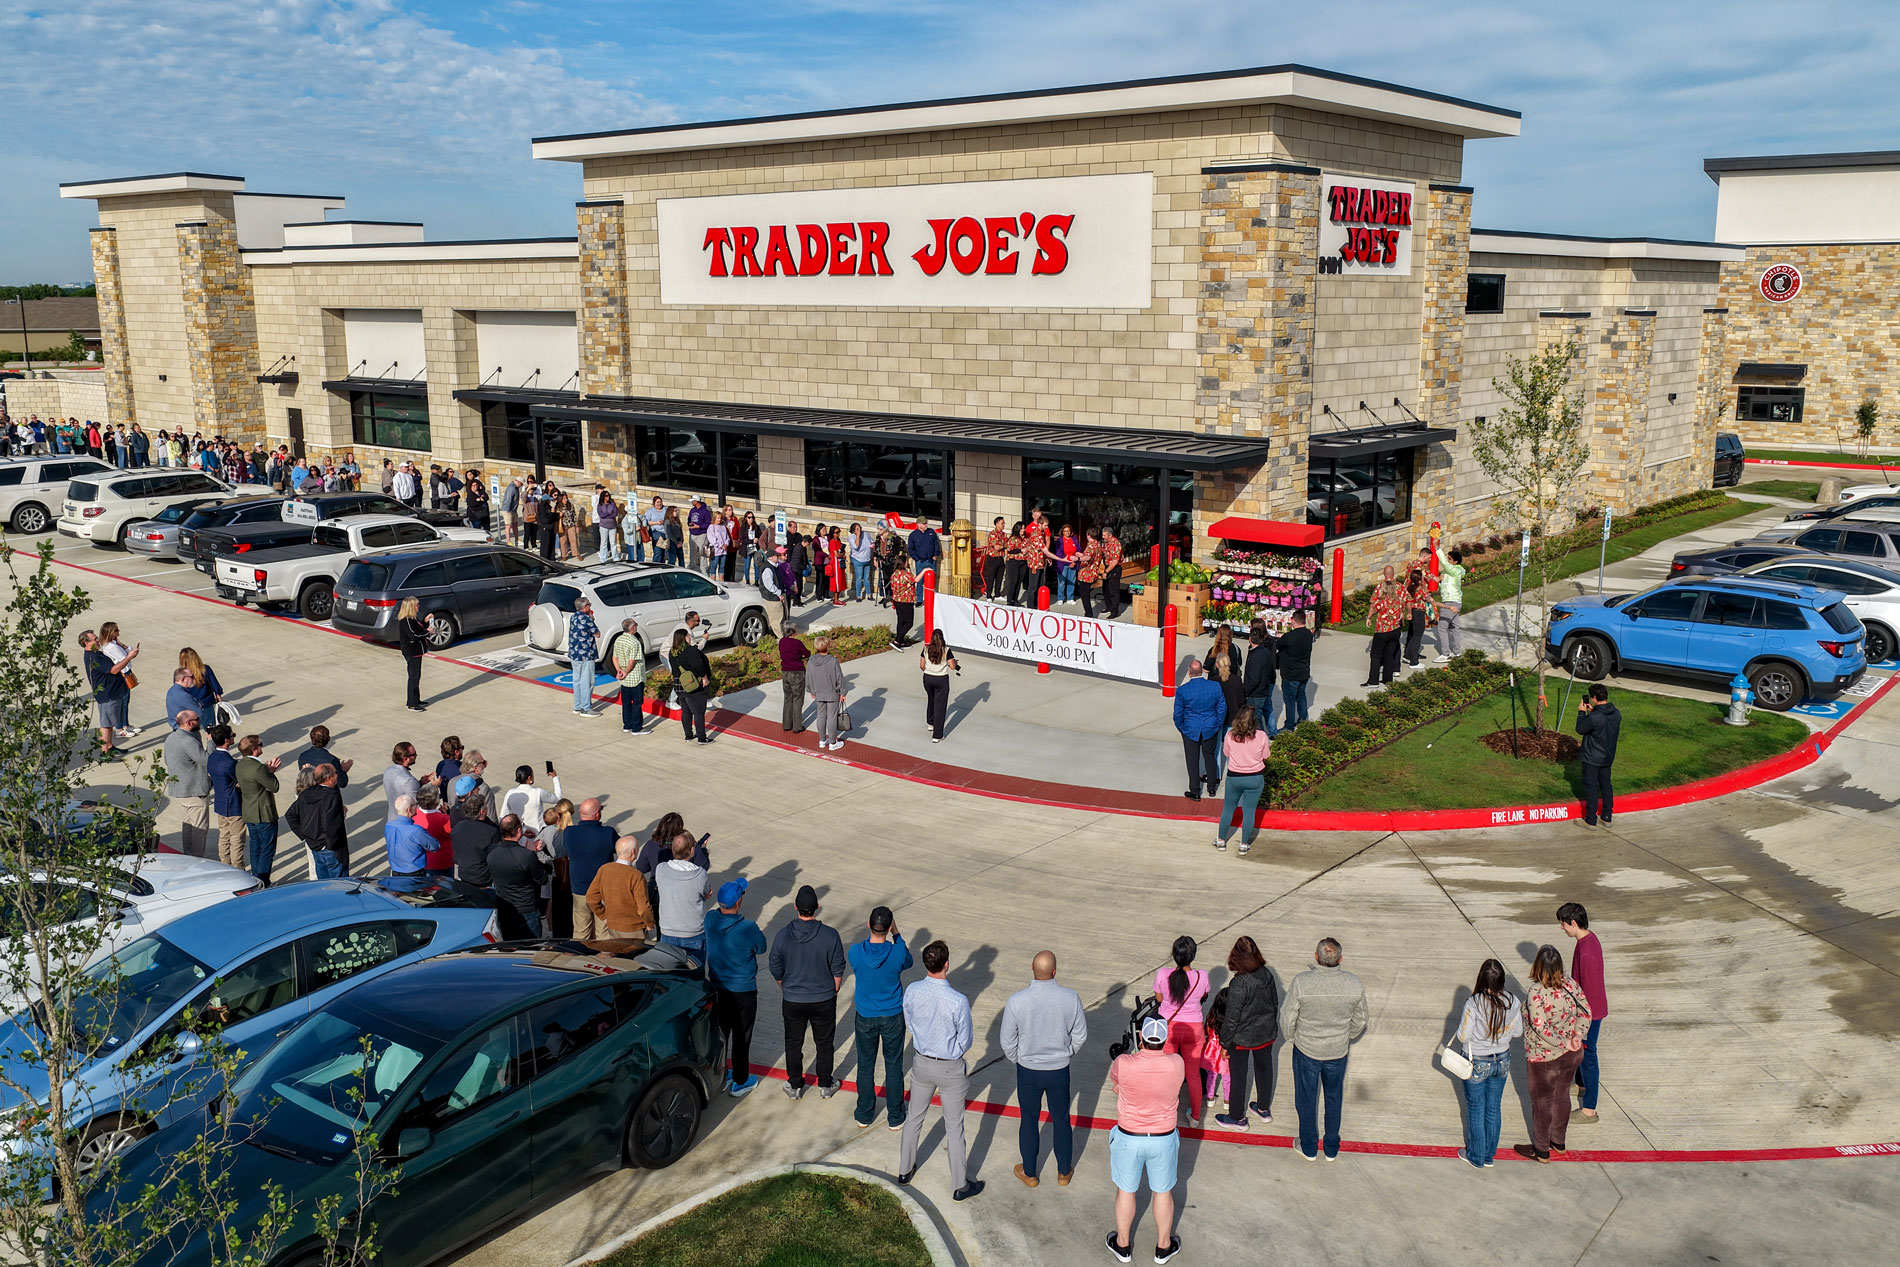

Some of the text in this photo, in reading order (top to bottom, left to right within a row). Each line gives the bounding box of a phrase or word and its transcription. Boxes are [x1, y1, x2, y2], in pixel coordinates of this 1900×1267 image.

[1327, 185, 1412, 226] TRADER
[703, 211, 1076, 278] TRADER JOE'S
[1339, 227, 1400, 264] JOE'S
[1764, 267, 1798, 280] CHIPOTLE
[1764, 286, 1797, 298] MEXICAN GRILL
[971, 603, 1116, 650] NOW OPEN
[986, 632, 1010, 650] 9:00
[1012, 638, 1036, 655] AM
[1045, 643, 1071, 660] 9:00
[1074, 647, 1097, 665] PM
[1491, 806, 1569, 824] FIRE LANE NO PARKING
[1835, 1144, 1887, 1155] PARKING
